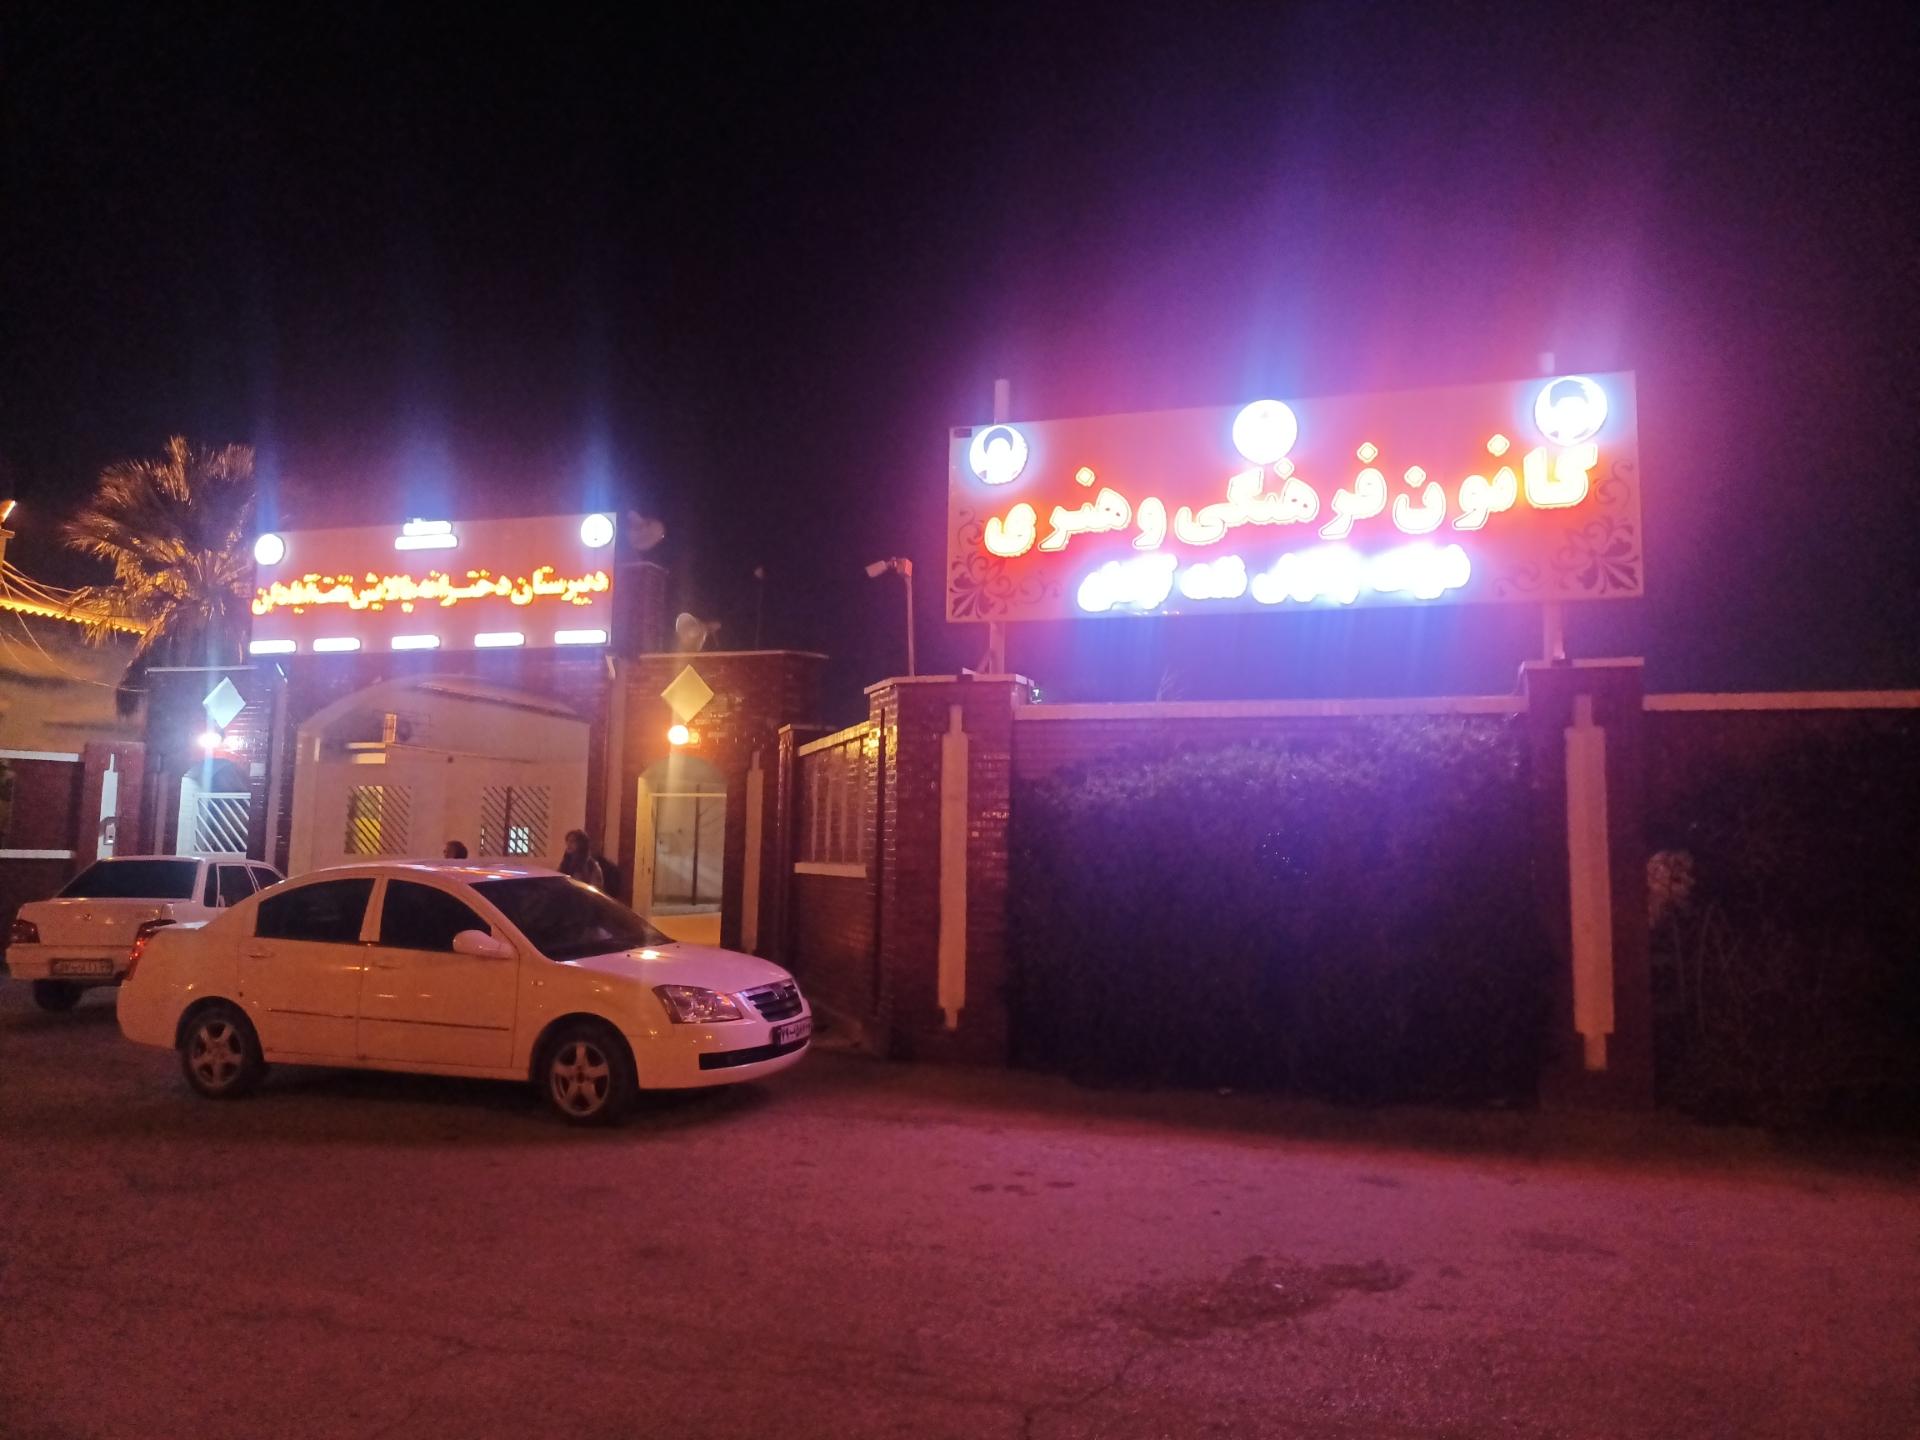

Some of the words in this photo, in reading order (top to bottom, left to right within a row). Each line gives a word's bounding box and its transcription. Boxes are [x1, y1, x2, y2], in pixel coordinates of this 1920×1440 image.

[984, 467, 1130, 558] هنری
[1174, 443, 1389, 546] فرهنگی
[1393, 434, 1599, 535] کانون
[1133, 497, 1167, 551] و
[418, 569, 512, 606] دخترانه
[511, 566, 609, 605] دبیرستان
